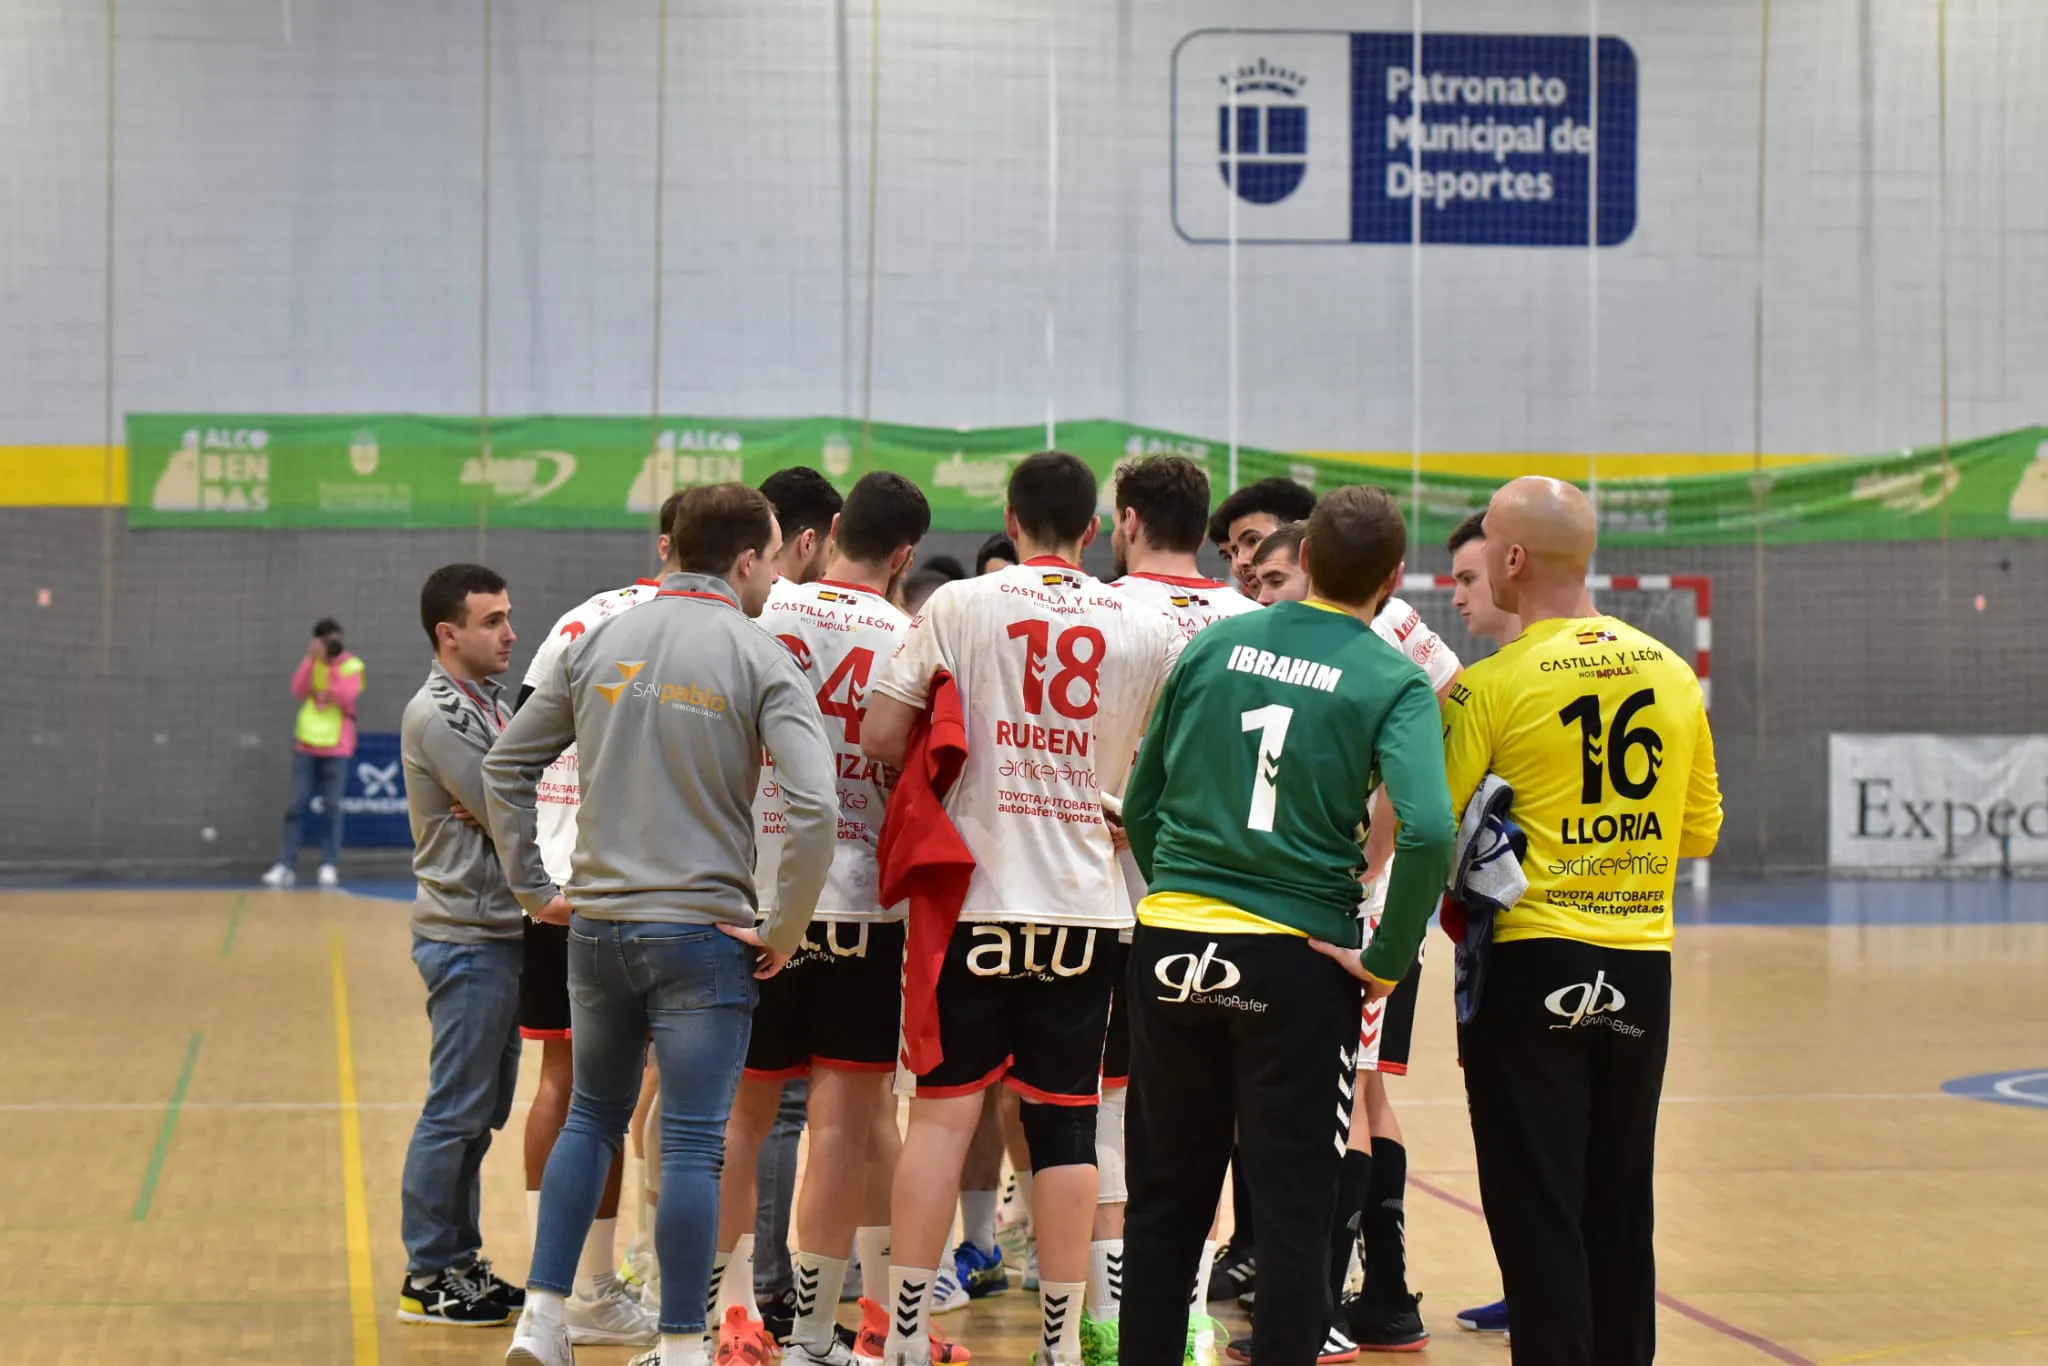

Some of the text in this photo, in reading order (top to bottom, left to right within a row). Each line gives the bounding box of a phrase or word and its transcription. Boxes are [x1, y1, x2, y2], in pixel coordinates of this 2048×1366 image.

[1386, 67, 1567, 104] Patronato
[1386, 115, 1594, 162] Municipal de
[1386, 163, 1554, 210] Deportes
[204, 453, 269, 481] BEN
[204, 485, 270, 511] DAS
[1000, 584, 1123, 611] CASTILLA Y LEÓN
[771, 602, 836, 620] CASTILLA
[844, 613, 854, 624] Y
[857, 615, 896, 633] LEÓN
[1007, 619, 1106, 719] 18
[1226, 645, 1342, 693] IBRAHIM
[1540, 647, 1663, 672] CASTILLA Y LEÓN
[671, 702, 722, 721] INMOBILIARIA
[996, 720, 1089, 757] RUBEN
[1559, 688, 1663, 805] 16
[1241, 704, 1294, 833] 1
[998, 790, 1041, 804] TOYOTA
[1562, 812, 1662, 845] LLORIA
[1548, 849, 1668, 876] archicerámica
[1545, 889, 1664, 902] TOYOTA AUTOBAFER
[966, 922, 1097, 977] atu
[1190, 993, 1269, 1013] GrupoBafer
